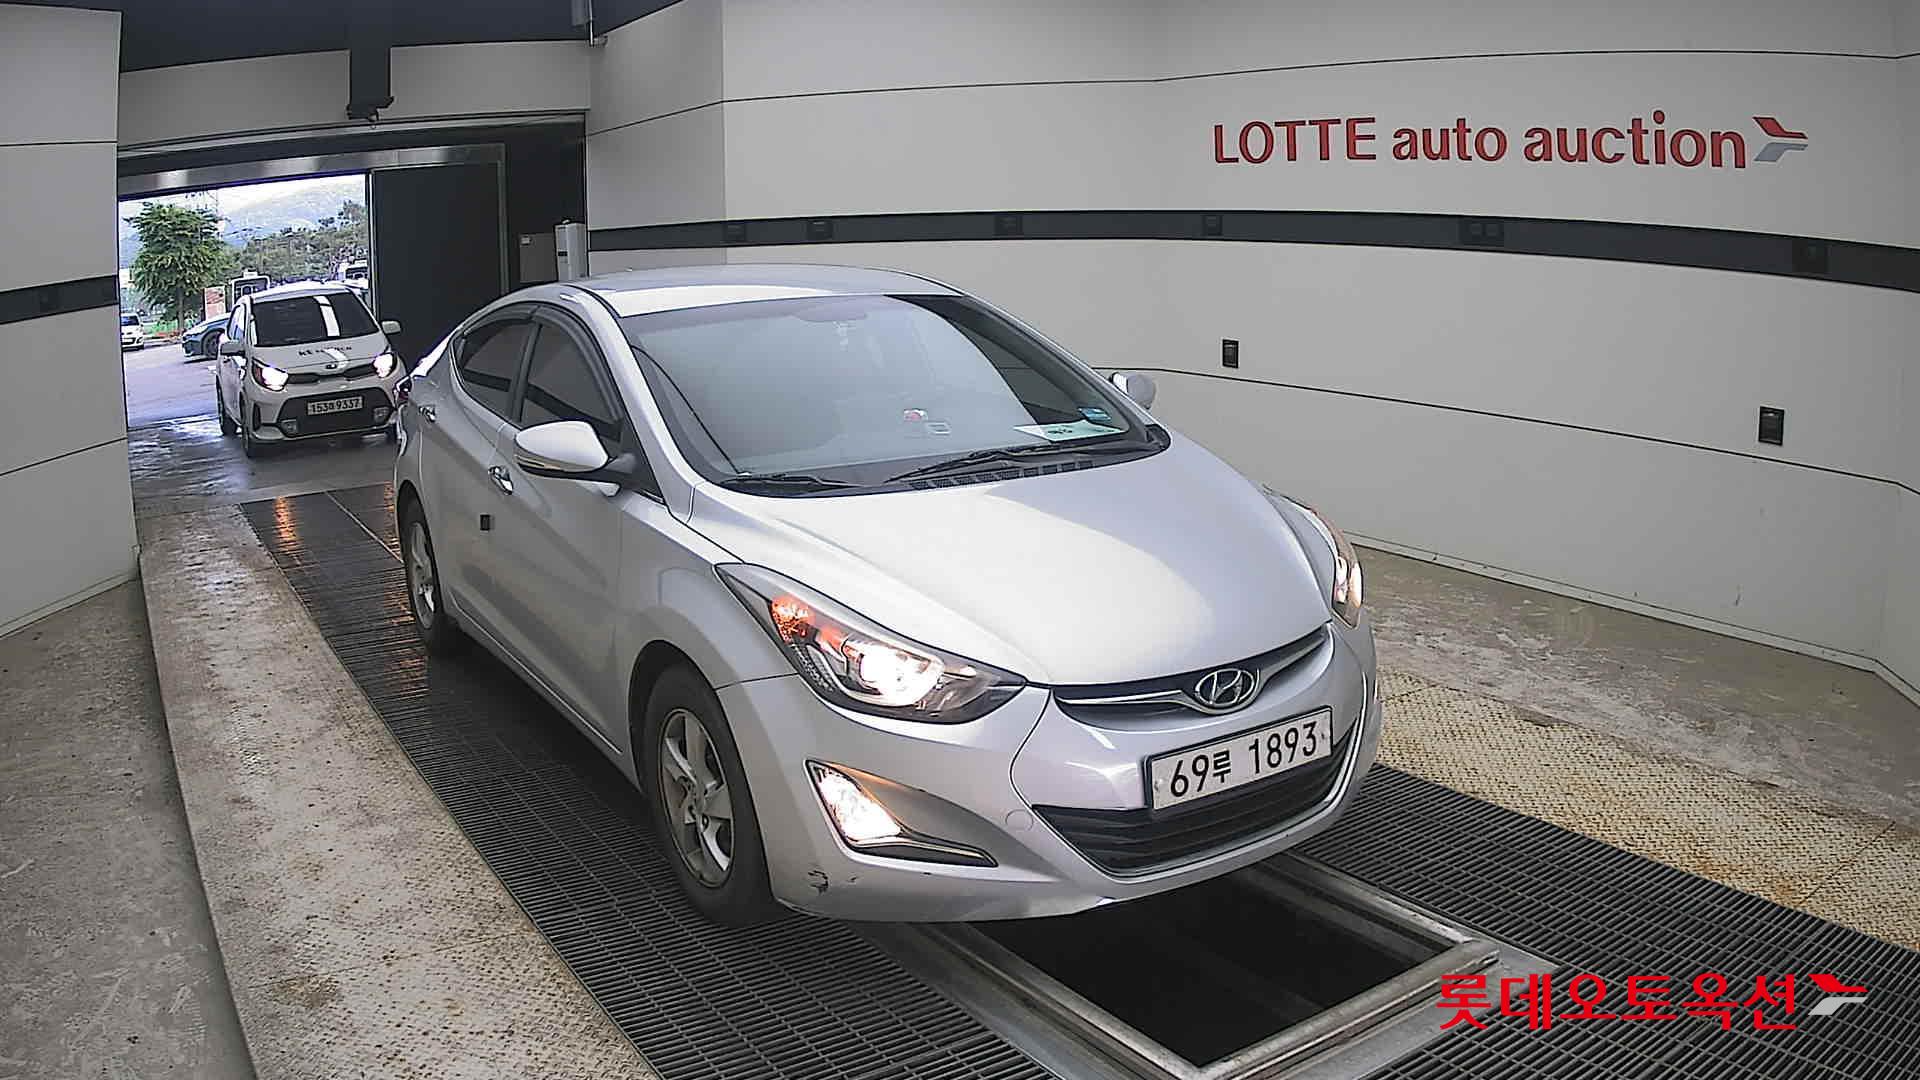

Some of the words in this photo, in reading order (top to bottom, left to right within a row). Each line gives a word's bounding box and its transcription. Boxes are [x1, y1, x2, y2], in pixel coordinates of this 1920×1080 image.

[1213, 117, 1377, 164] LOTTE
[1392, 118, 1509, 161] auto
[1523, 110, 1747, 168] auction
[1170, 750, 1232, 797] 69루
[1248, 720, 1317, 774] 1893
